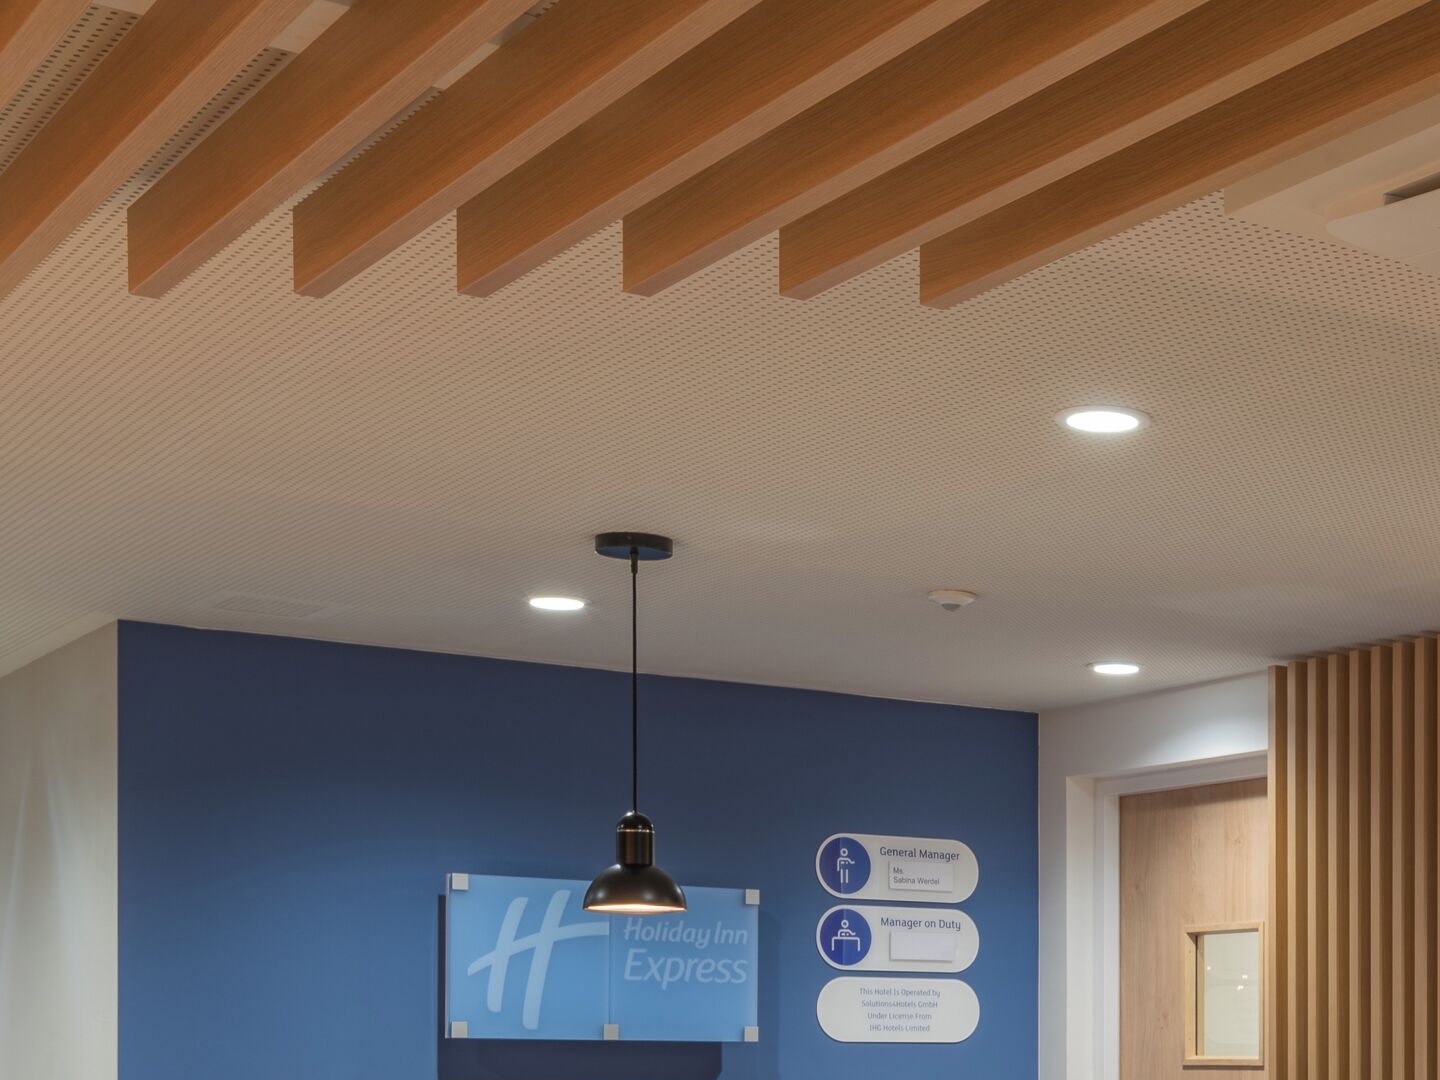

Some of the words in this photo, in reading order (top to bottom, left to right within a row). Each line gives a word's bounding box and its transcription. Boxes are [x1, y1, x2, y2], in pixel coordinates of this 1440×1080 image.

[880, 846, 917, 858] General
[919, 849, 960, 862] Manager
[893, 876, 916, 884] Sabina
[917, 877, 940, 885] Werdel
[880, 917, 922, 930] Manager
[924, 920, 937, 928] on
[938, 919, 961, 932] Duty
[624, 917, 711, 949] Holiday
[714, 920, 748, 945] Inn
[623, 947, 749, 991] Express
[860, 988, 873, 996] This
[875, 988, 892, 996] Hotel
[901, 989, 931, 998] Operated
[932, 989, 941, 998] by
[867, 1012, 887, 1020] Under
[889, 1012, 914, 1020] License
[870, 1024, 882, 1032] IHG
[883, 1024, 904, 1032] Hotels
[905, 1024, 930, 1032] Limited
